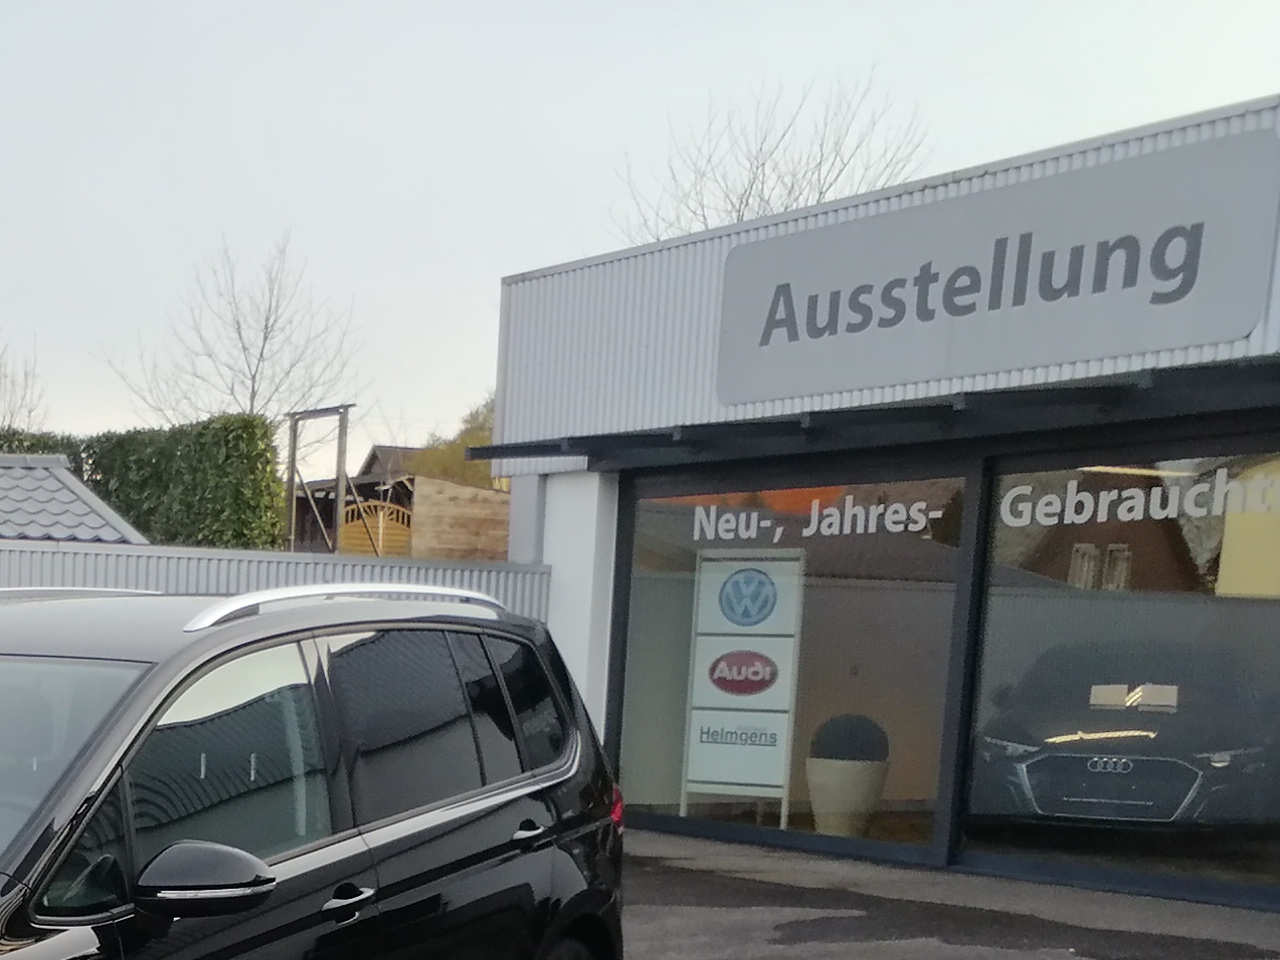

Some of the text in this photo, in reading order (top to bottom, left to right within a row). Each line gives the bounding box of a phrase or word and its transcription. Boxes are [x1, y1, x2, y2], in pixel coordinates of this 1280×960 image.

[759, 222, 1205, 347] Ausstellung
[693, 467, 1279, 543] Neu-, Jahres- Gebraucht
[711, 661, 772, 681] Audi
